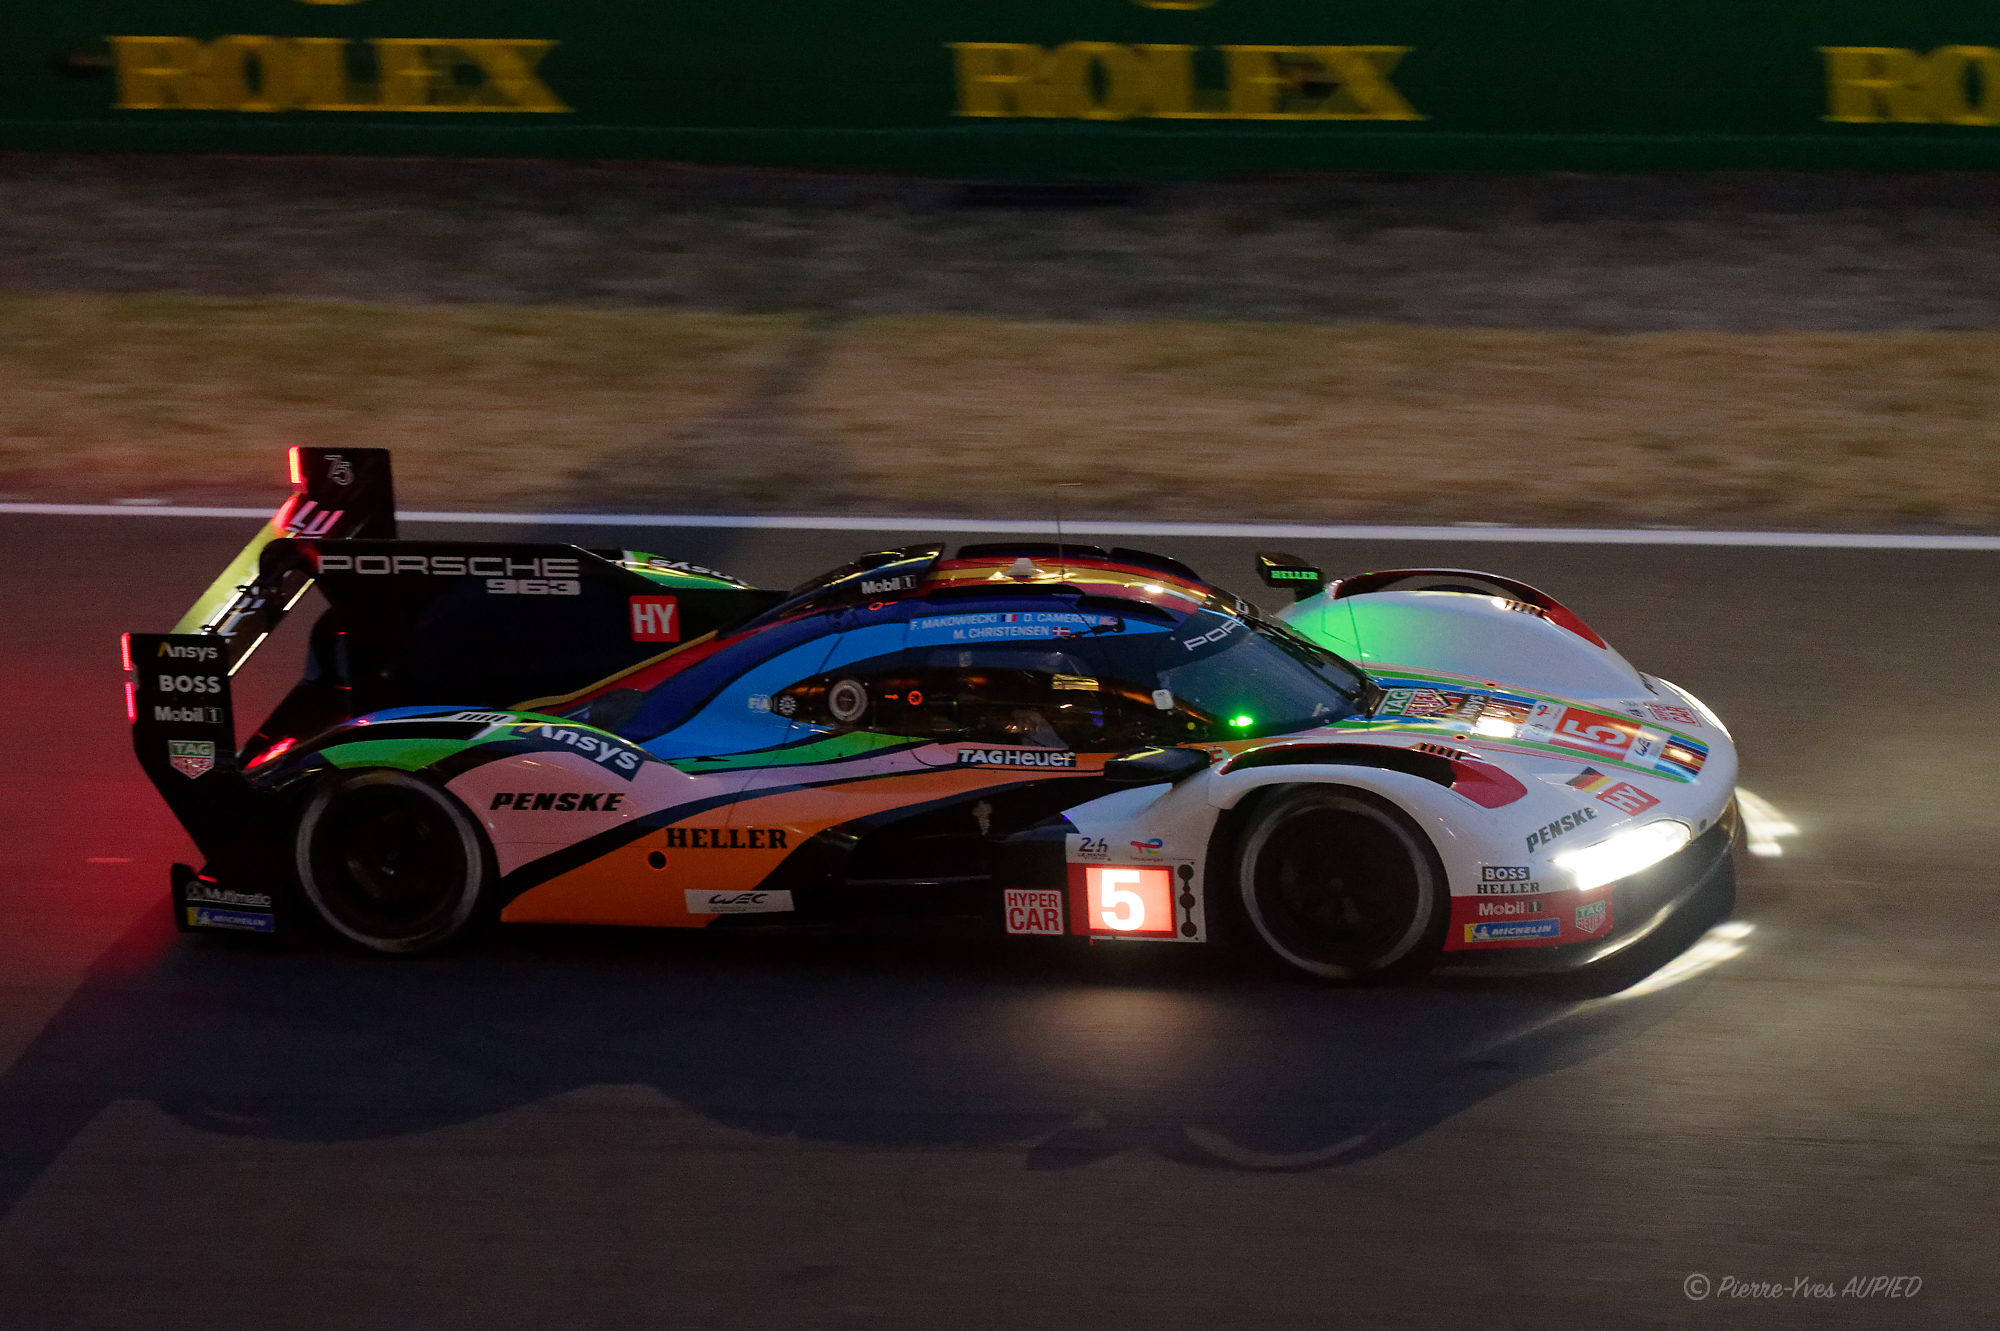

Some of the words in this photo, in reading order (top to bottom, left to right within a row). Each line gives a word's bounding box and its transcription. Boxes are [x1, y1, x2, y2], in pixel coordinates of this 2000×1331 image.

[106, 35, 574, 114] ROLEX
[946, 41, 1428, 122] ROLEX
[317, 554, 580, 578] PORSCHE
[1271, 570, 1319, 581] HELLER
[486, 578, 581, 596] 963
[861, 577, 901, 595] Mobil
[632, 603, 675, 634] HY
[1034, 613, 1096, 625] CAMERON
[968, 626, 1049, 639] CHRISTENSEN
[158, 642, 219, 662] Ansys
[159, 675, 222, 694] BOSS
[1382, 691, 1411, 715] TAG
[154, 706, 203, 723] Mobil
[1562, 719, 1627, 746] 5
[174, 743, 212, 756] TAG
[519, 724, 640, 771] Ansys
[489, 793, 625, 812] PENSKE
[1603, 785, 1652, 812] HY
[665, 828, 788, 849] HELLER
[1525, 806, 1599, 855] PENSKE
[1485, 868, 1528, 881] BOSS
[1477, 882, 1541, 894] HELLER
[708, 893, 768, 904] WEC
[1007, 892, 1058, 908] HYPER
[1100, 869, 1145, 931] 5
[1478, 901, 1525, 916] Mobil
[1577, 904, 1604, 919] TAG
[1009, 907, 1060, 931] CAR
[1491, 925, 1552, 936] MICHELIN
